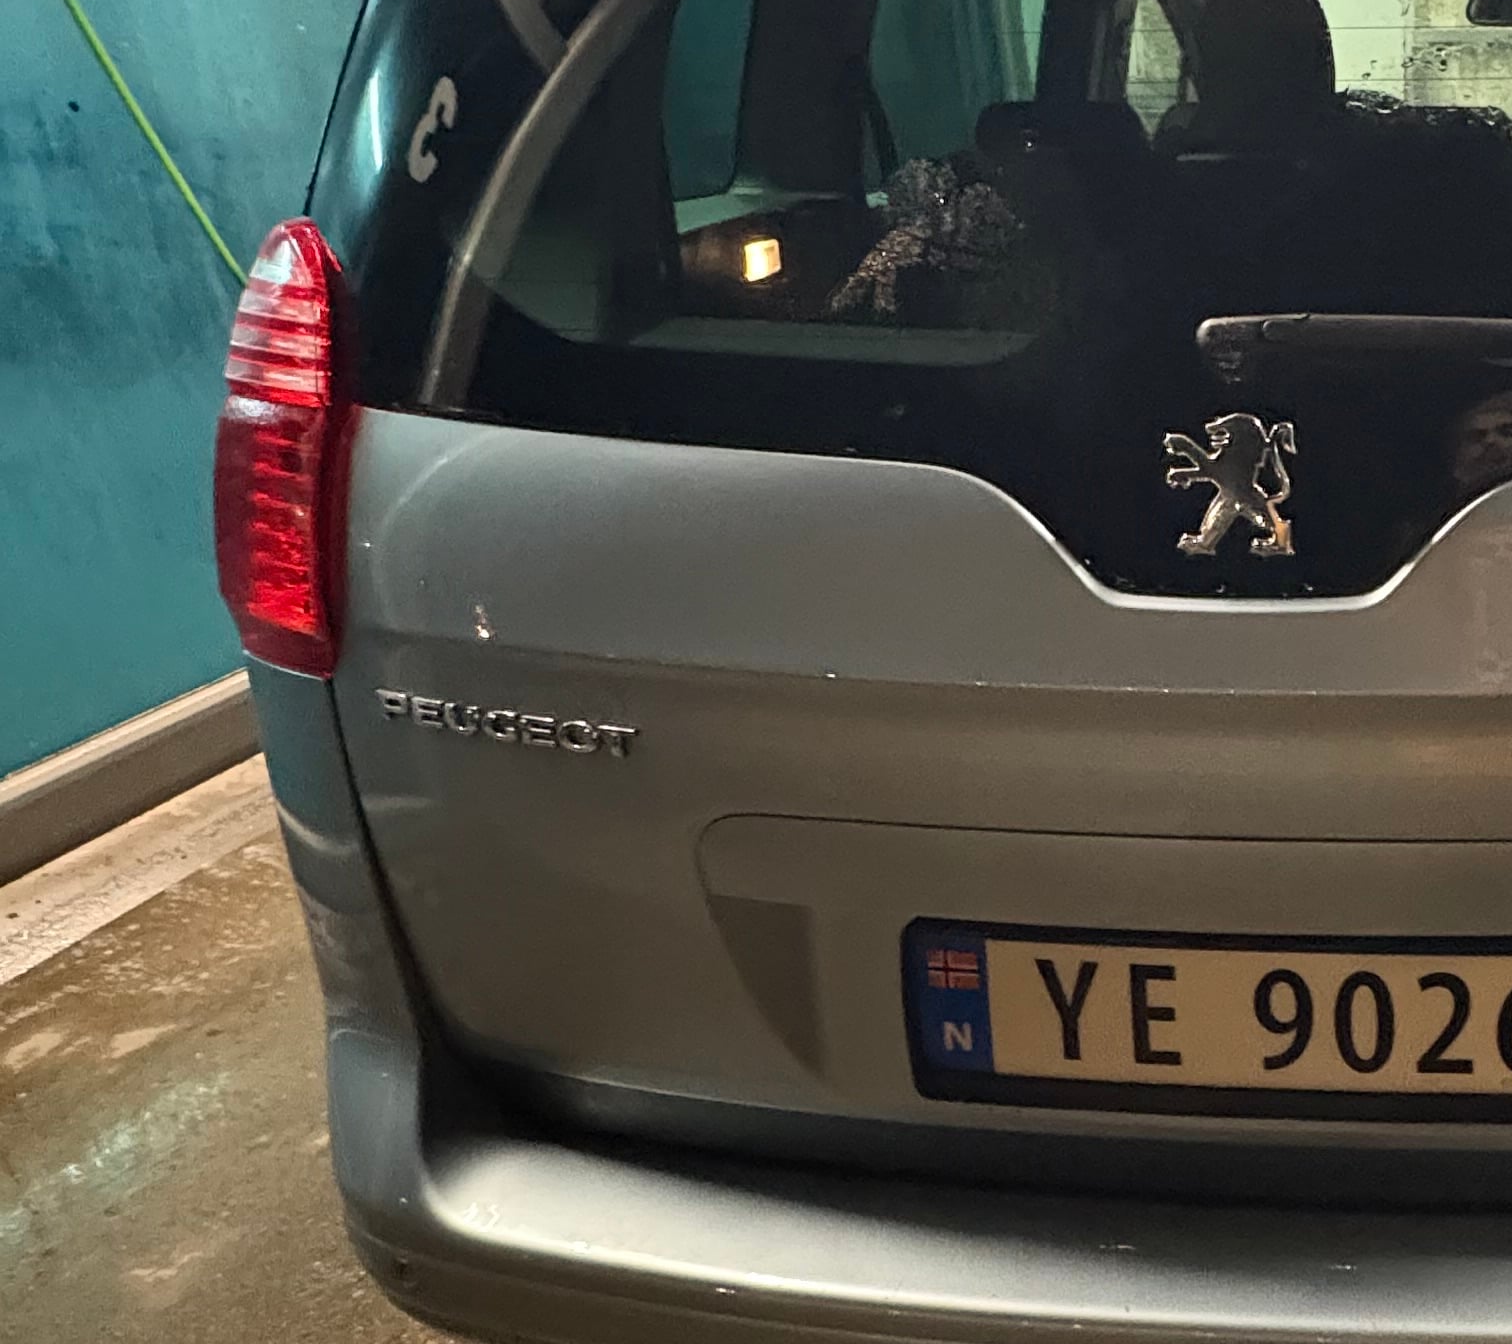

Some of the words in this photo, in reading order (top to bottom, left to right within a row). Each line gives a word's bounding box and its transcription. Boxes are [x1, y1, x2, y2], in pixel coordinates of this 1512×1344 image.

[375, 688, 640, 758] PEUGEOT
[943, 1021, 973, 1052] N
[1034, 957, 1182, 1067] YE
